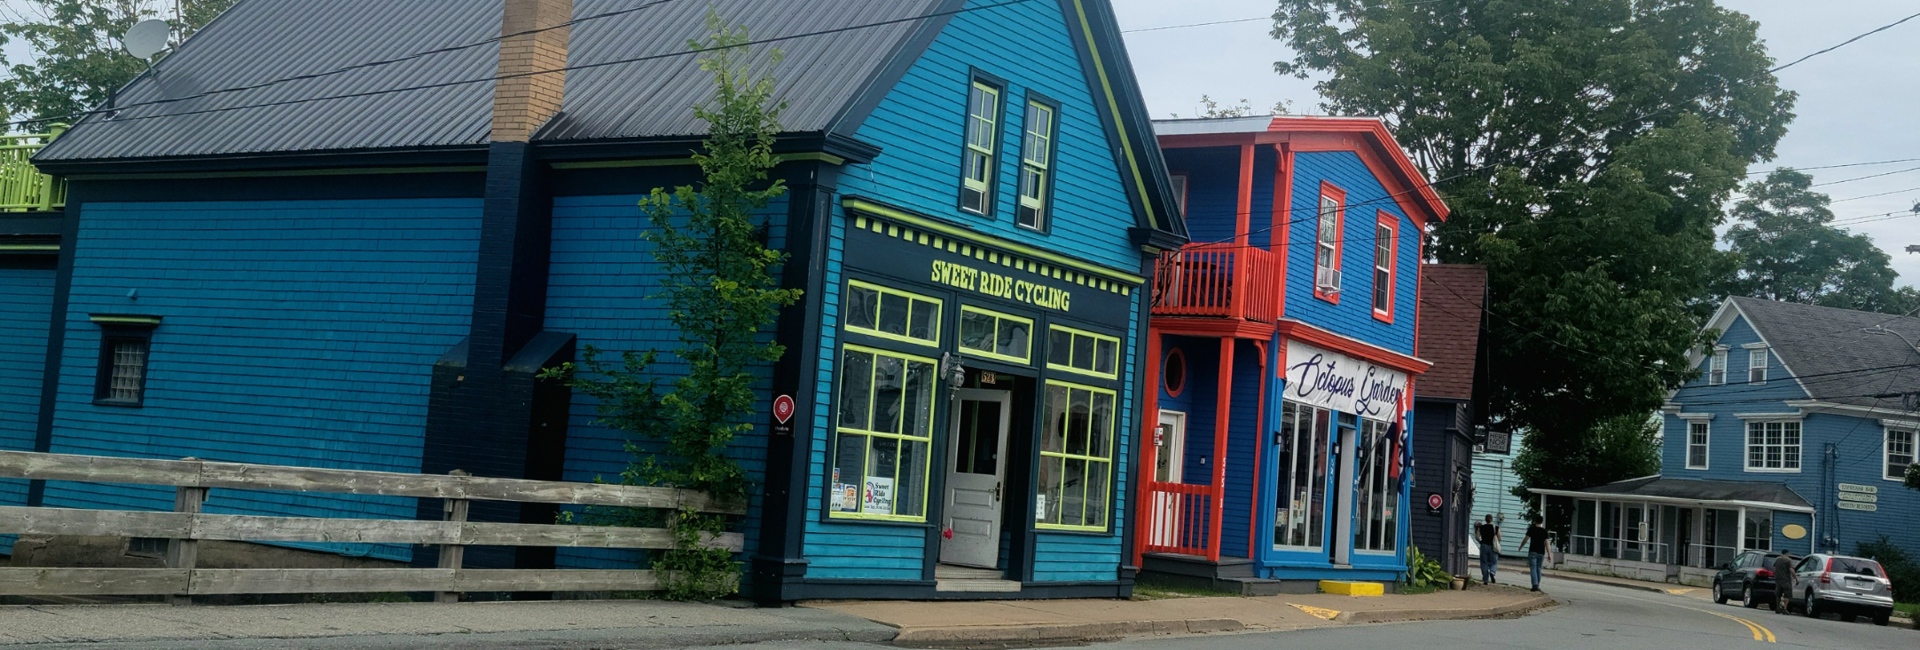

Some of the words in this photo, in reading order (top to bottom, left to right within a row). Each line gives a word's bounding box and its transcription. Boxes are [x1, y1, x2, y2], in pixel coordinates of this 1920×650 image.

[931, 259, 978, 291] SWEET
[979, 271, 1013, 299] RIDE
[1015, 279, 1071, 312] CYCLING
[983, 371, 995, 383] 523
[1490, 433, 1507, 441] HERE
[1490, 439, 1506, 447] NOR
[875, 482, 889, 490] Sweet
[873, 497, 891, 506] Cycling
